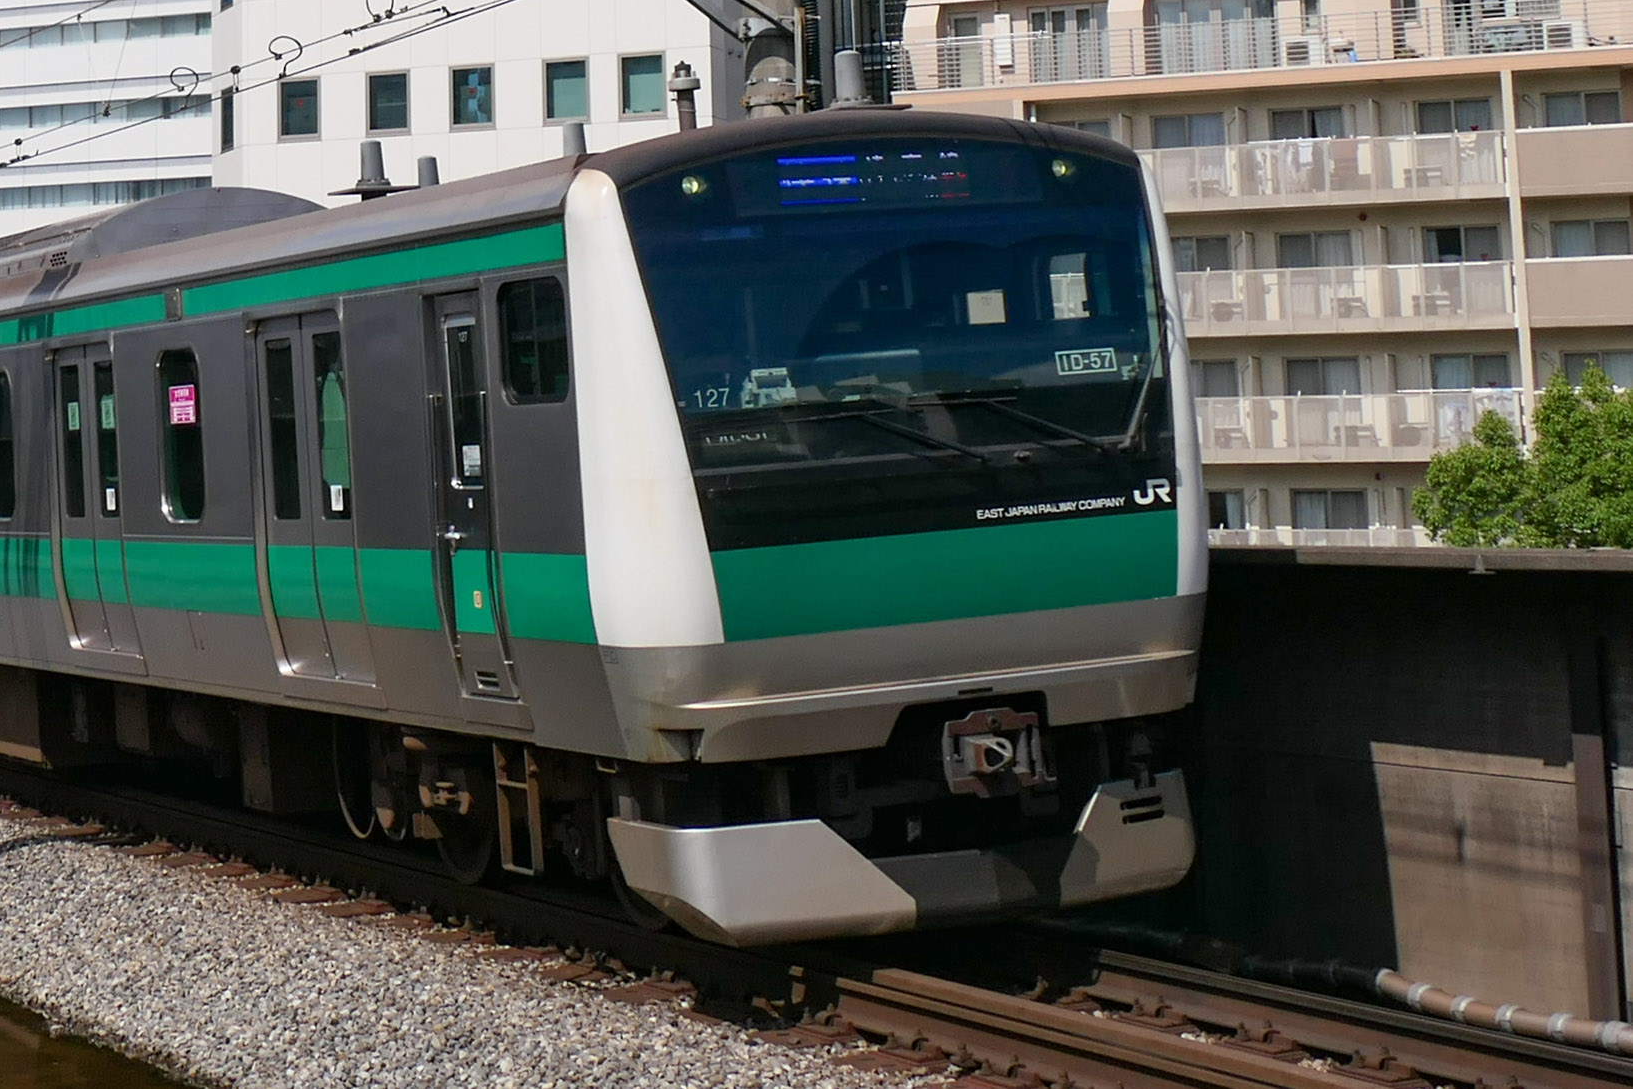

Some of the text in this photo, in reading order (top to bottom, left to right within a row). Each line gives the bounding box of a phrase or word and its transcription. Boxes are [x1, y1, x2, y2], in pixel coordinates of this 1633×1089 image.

[693, 388, 730, 409] 127
[1133, 478, 1173, 506] JR
[976, 496, 1126, 520] EAST JAPAN RAILWAY COMPANY
